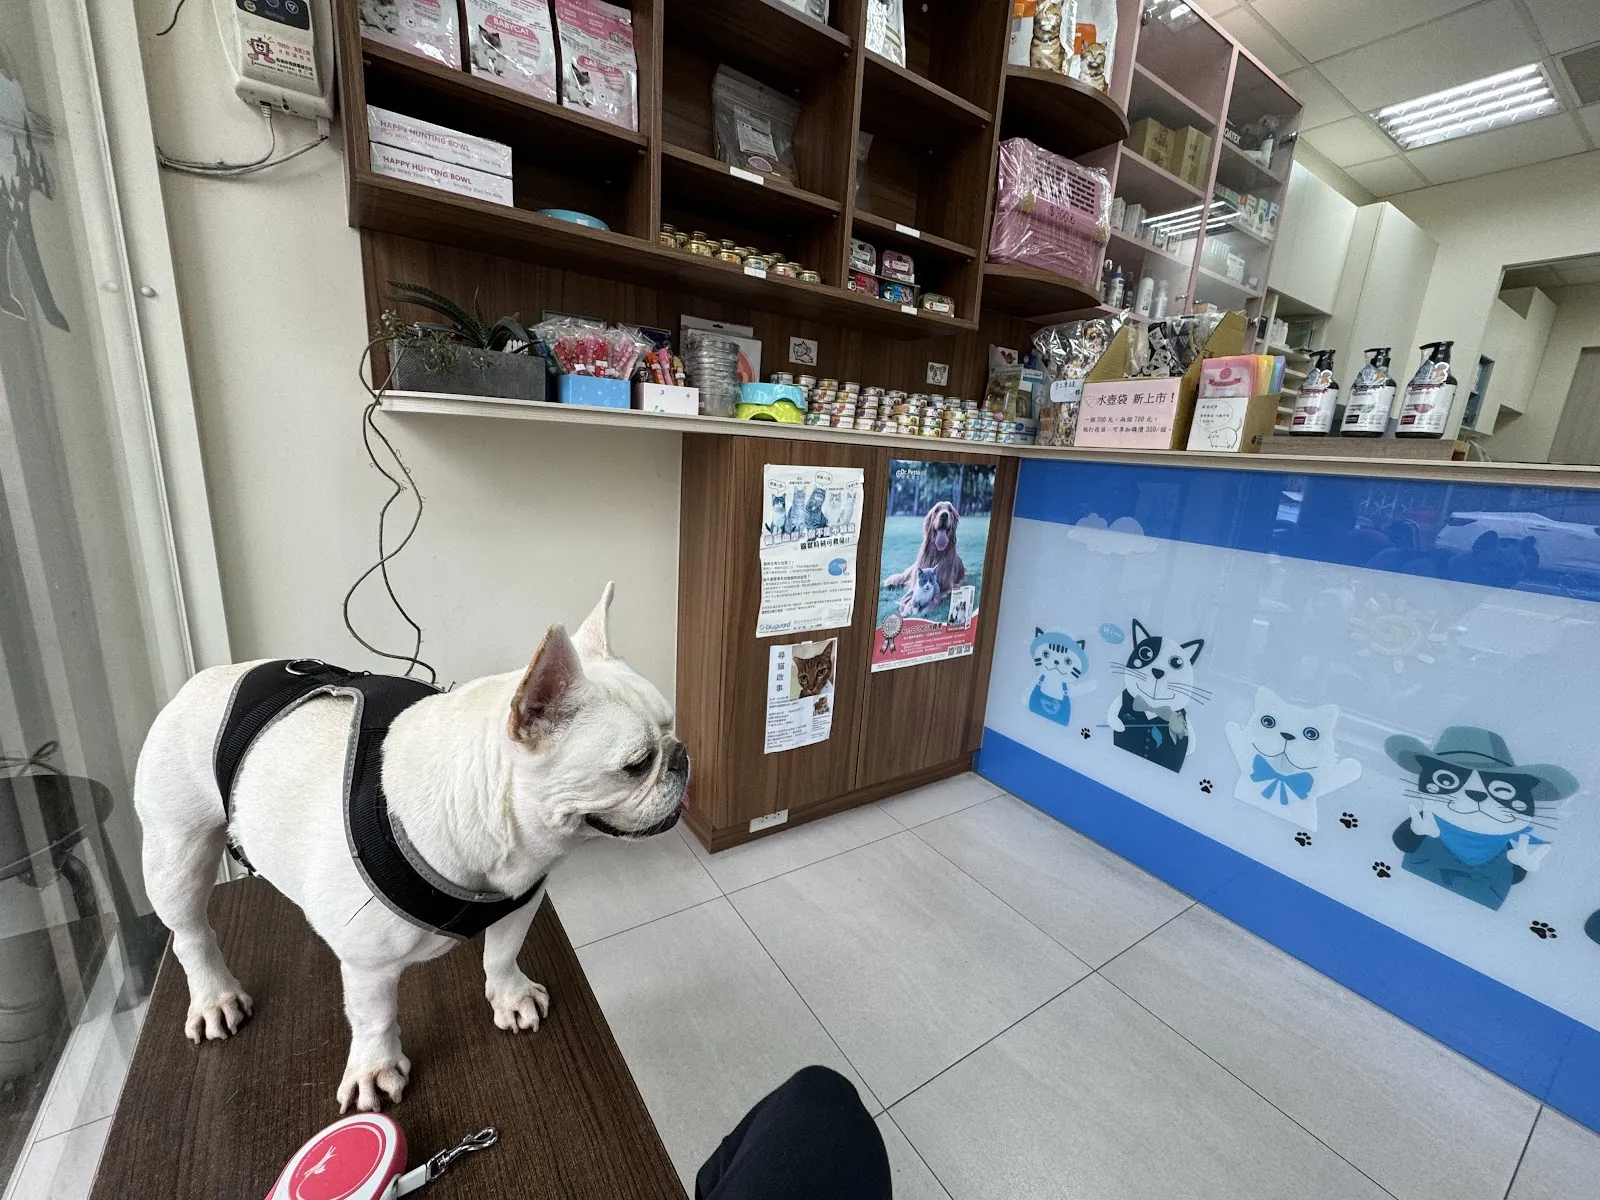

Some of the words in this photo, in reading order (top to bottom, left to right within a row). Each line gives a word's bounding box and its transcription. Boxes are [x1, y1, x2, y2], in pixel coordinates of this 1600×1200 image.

[493, 17, 530, 36] BABYCAT
[380, 120, 408, 132] HAPPY
[410, 129, 446, 145] HUNTING
[448, 139, 470, 152] BOWL
[383, 155, 410, 168] HAPPY
[411, 163, 448, 178] HUNTING
[450, 173, 472, 185] BOWL
[1096, 394, 1128, 406] 水壺袋
